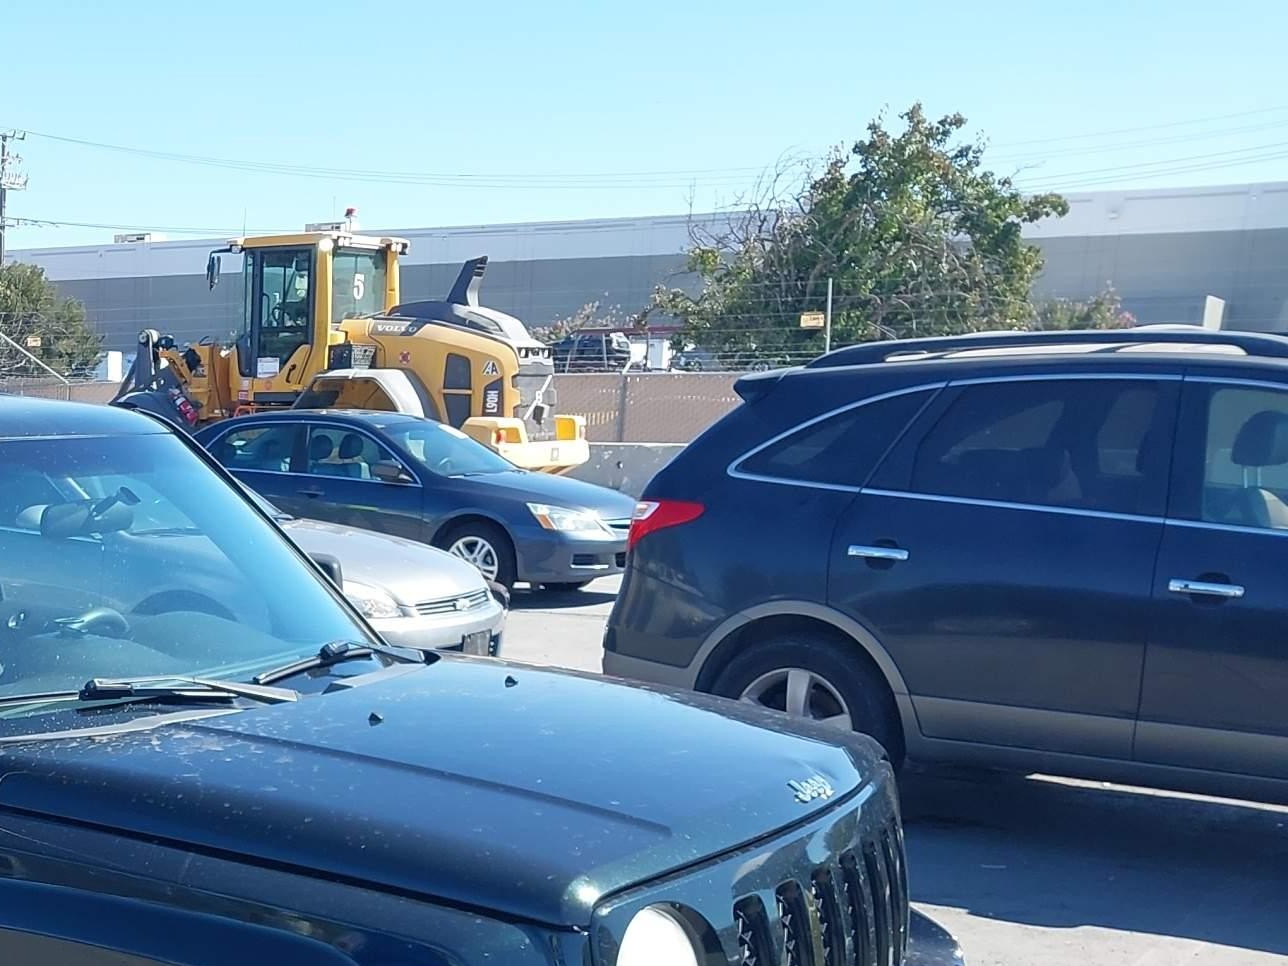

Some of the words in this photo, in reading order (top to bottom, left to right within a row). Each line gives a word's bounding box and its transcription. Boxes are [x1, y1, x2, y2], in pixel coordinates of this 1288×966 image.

[353, 273, 365, 300] 5
[376, 324, 417, 333] VOLVO
[485, 390, 499, 413] L90H
[787, 775, 834, 803] Jeep
